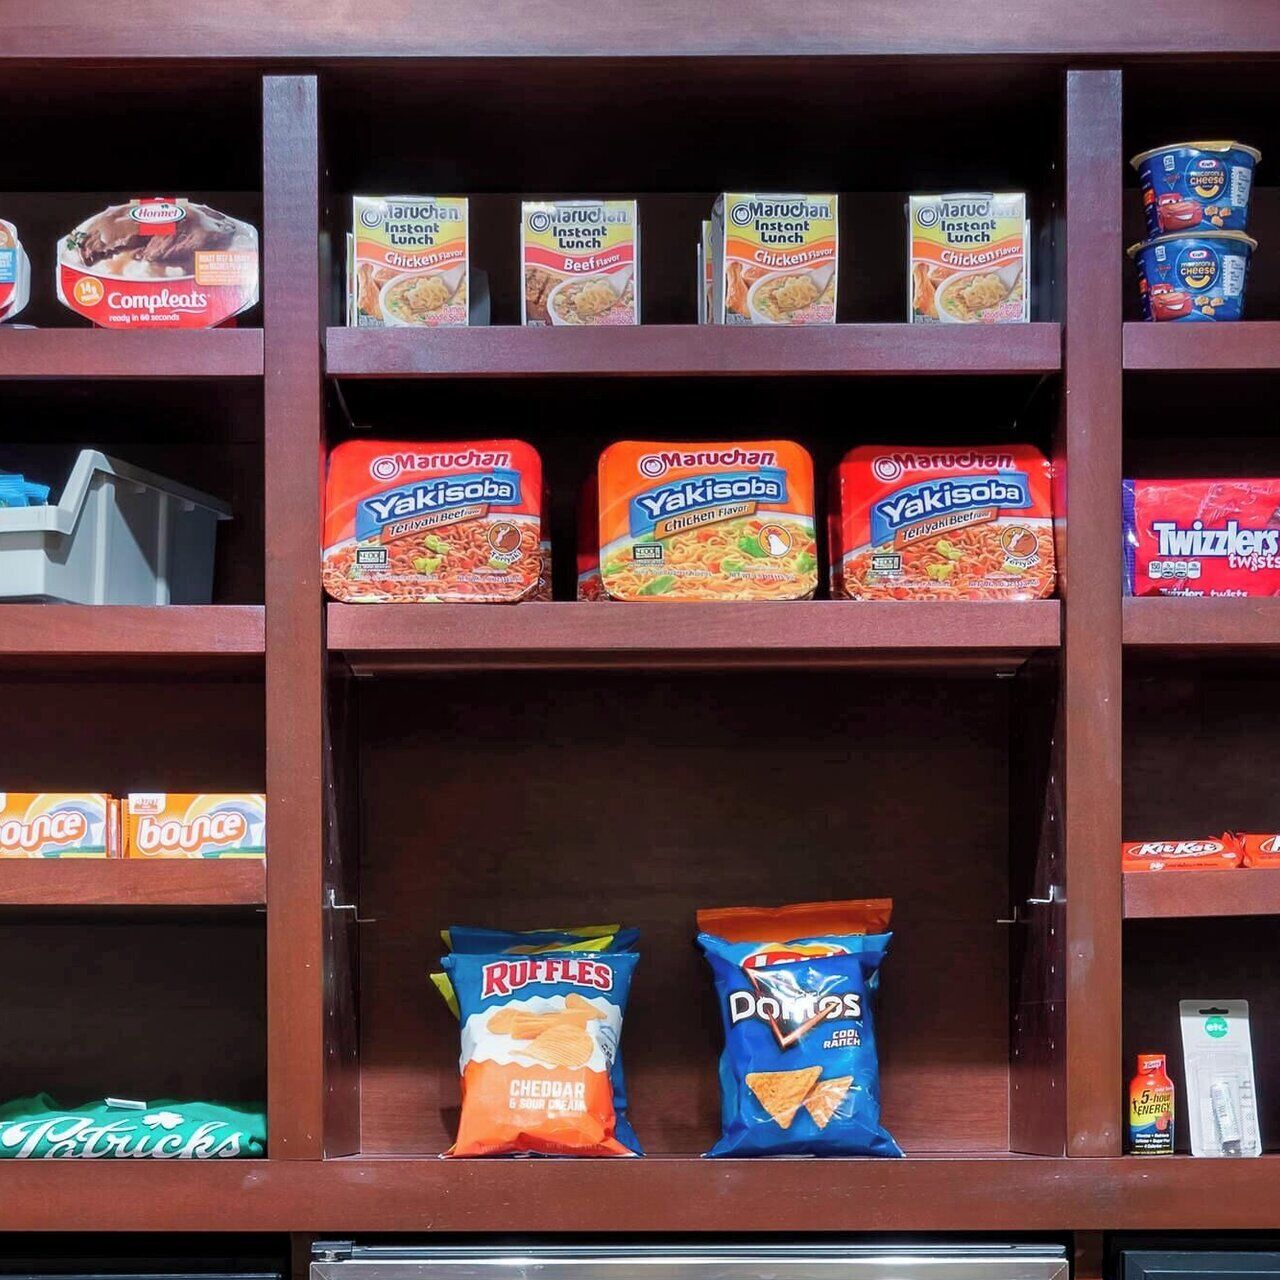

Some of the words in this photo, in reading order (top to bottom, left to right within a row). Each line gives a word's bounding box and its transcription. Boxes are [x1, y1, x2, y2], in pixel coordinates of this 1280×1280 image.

[138, 206, 178, 218] Hormel
[385, 222, 439, 233] Instant
[552, 226, 607, 237] Instant
[755, 220, 810, 231] Instant
[941, 220, 996, 231] Instant
[391, 234, 434, 245] Lunch
[558, 237, 601, 249] Lunch
[761, 232, 803, 243] Lunch
[947, 232, 990, 243] Lunch
[385, 252, 438, 267] Chicken
[439, 249, 464, 261] Flavor
[564, 256, 595, 271] Beef
[595, 253, 620, 267] Flavor
[755, 250, 807, 266] Chicken
[941, 250, 994, 266] Chicken
[108, 289, 207, 313] Compleats
[395, 452, 509, 469] Maruchan
[661, 451, 775, 467] Maruchan
[895, 454, 1013, 469] Maruchan
[370, 479, 511, 520] Yakisoba
[641, 477, 778, 516] Yakisoba
[884, 481, 1019, 523] Yakisoba
[389, 516, 439, 535] Teriyaki
[440, 510, 466, 523] Beef
[903, 519, 950, 540] Teriyaki
[950, 512, 974, 524] Beef
[1153, 521, 1279, 556] Twizzlers
[484, 960, 611, 996] RUFFLES
[833, 1029, 859, 1039] COOL
[1207, 1023, 1228, 1031] etc.
[823, 1037, 861, 1049] RANCH
[510, 1079, 586, 1098] CHEDDAR
[1141, 1089, 1170, 1104] 5-hour
[520, 1098, 546, 1110] SOUR
[548, 1099, 587, 1112] CREAM
[1138, 1102, 1170, 1116] ENERGY
